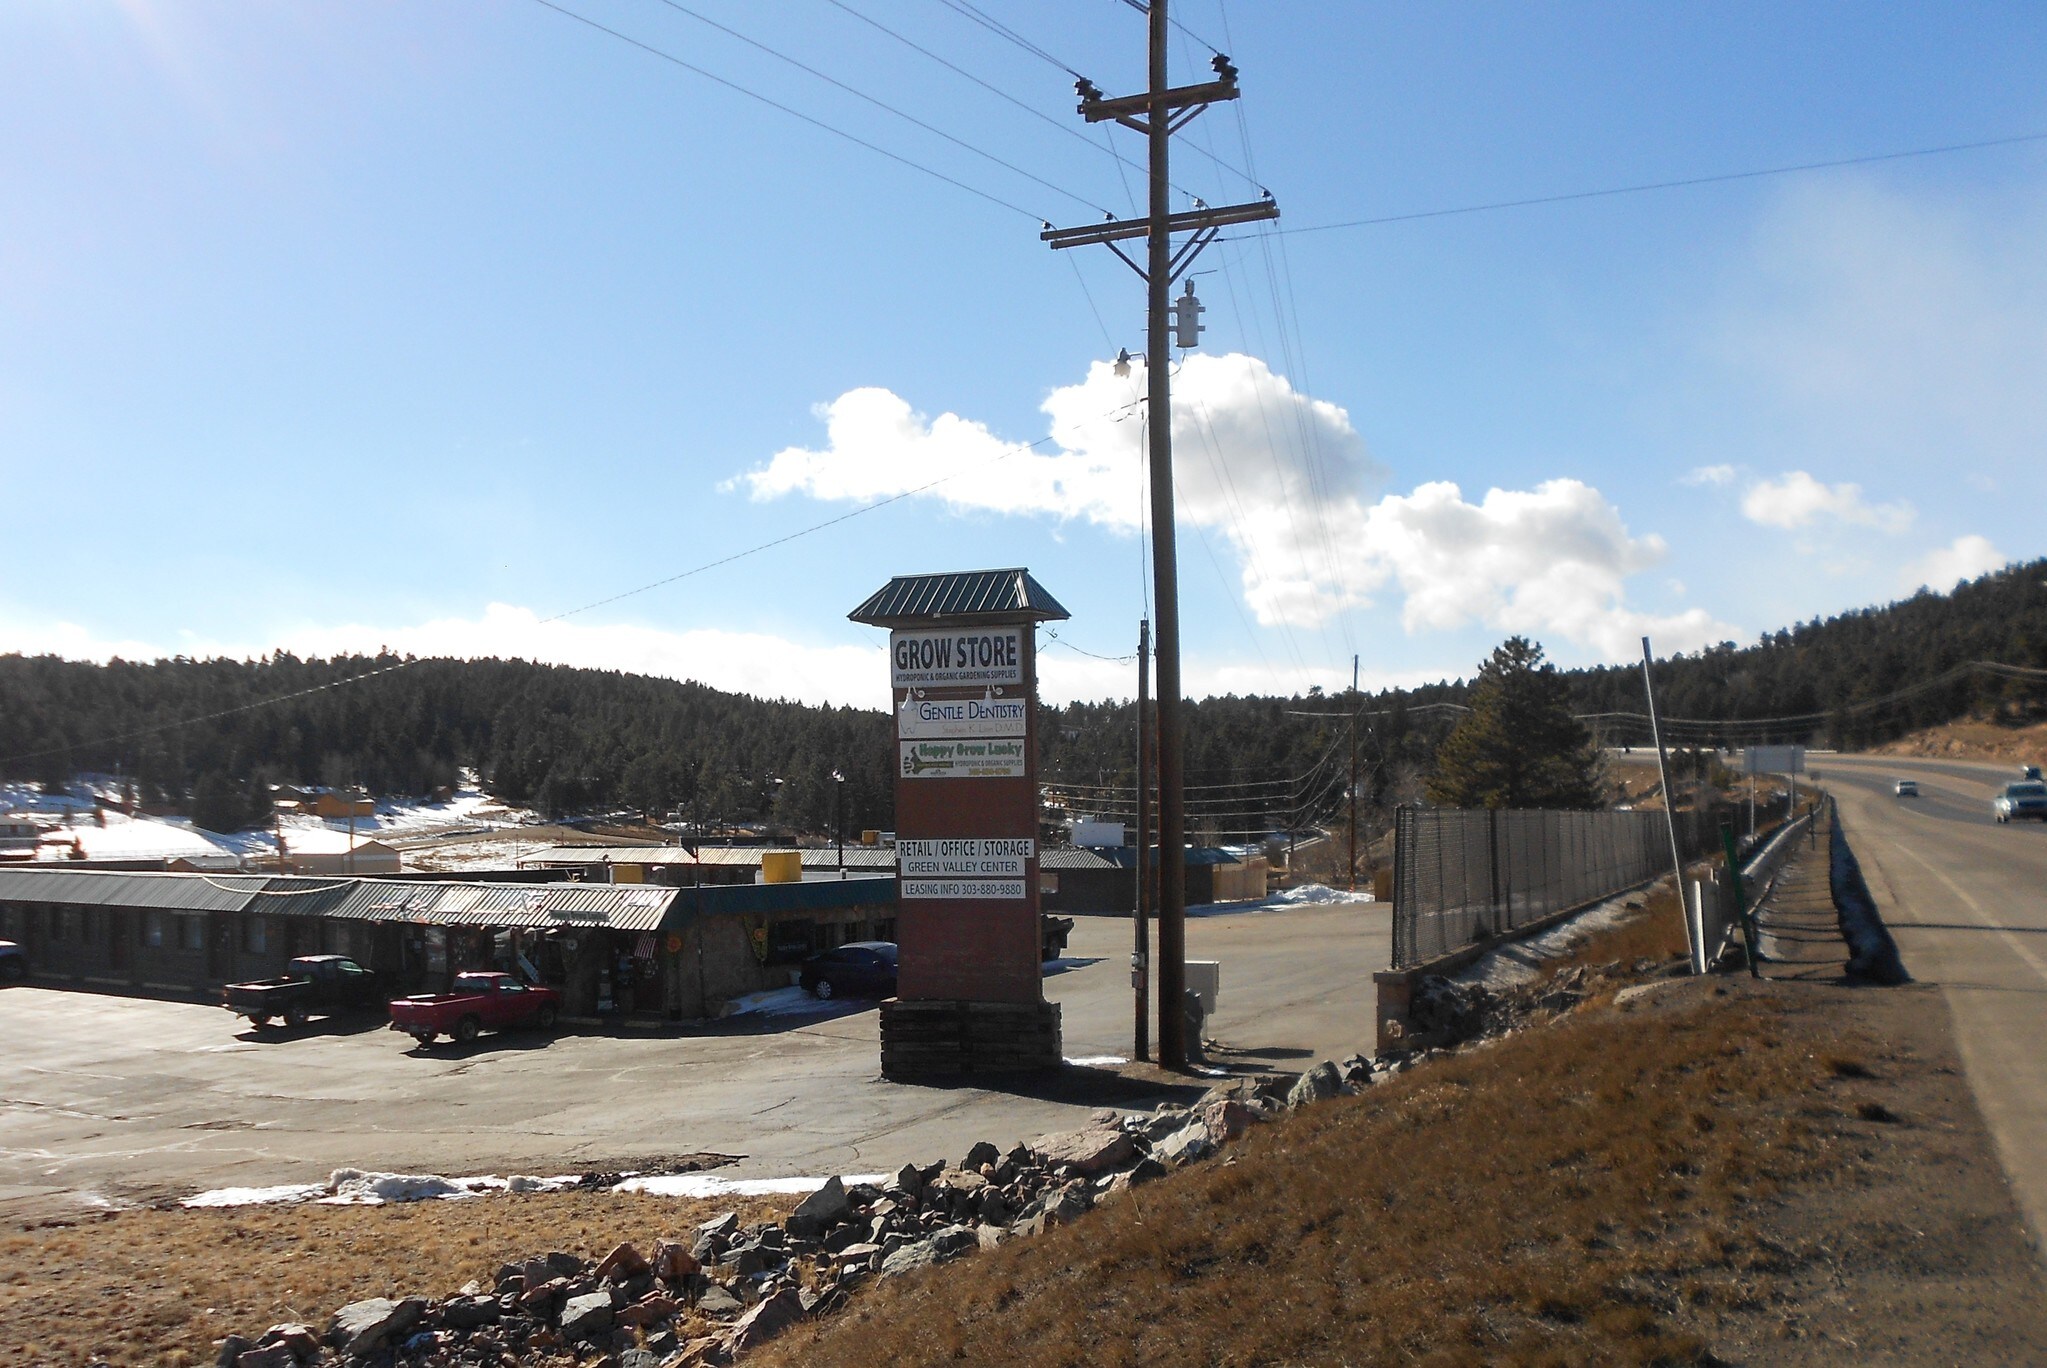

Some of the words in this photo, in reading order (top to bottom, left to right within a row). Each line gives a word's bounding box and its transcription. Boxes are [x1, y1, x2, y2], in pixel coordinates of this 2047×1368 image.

[895, 638, 952, 670] GROW
[956, 636, 1017, 668] STORE
[896, 673, 929, 682] HYDROPONIC
[930, 672, 934, 680] &
[935, 672, 958, 680] ORGANIC
[959, 670, 990, 680] GARDENING
[991, 670, 1017, 679] SUPPLIES
[919, 743, 954, 758] Happy
[956, 742, 986, 756] Grow
[988, 742, 1022, 757] Lucky
[900, 842, 932, 857] RETAIL
[942, 841, 975, 856] OFFICE
[984, 840, 1029, 856] STORAGE
[908, 862, 940, 872] GREEN
[942, 862, 978, 872] VALLEY
[980, 862, 1018, 872] CENTER
[905, 884, 938, 895] LEASING
[940, 884, 960, 895] INFO
[962, 884, 1022, 895] 303-880-9880
